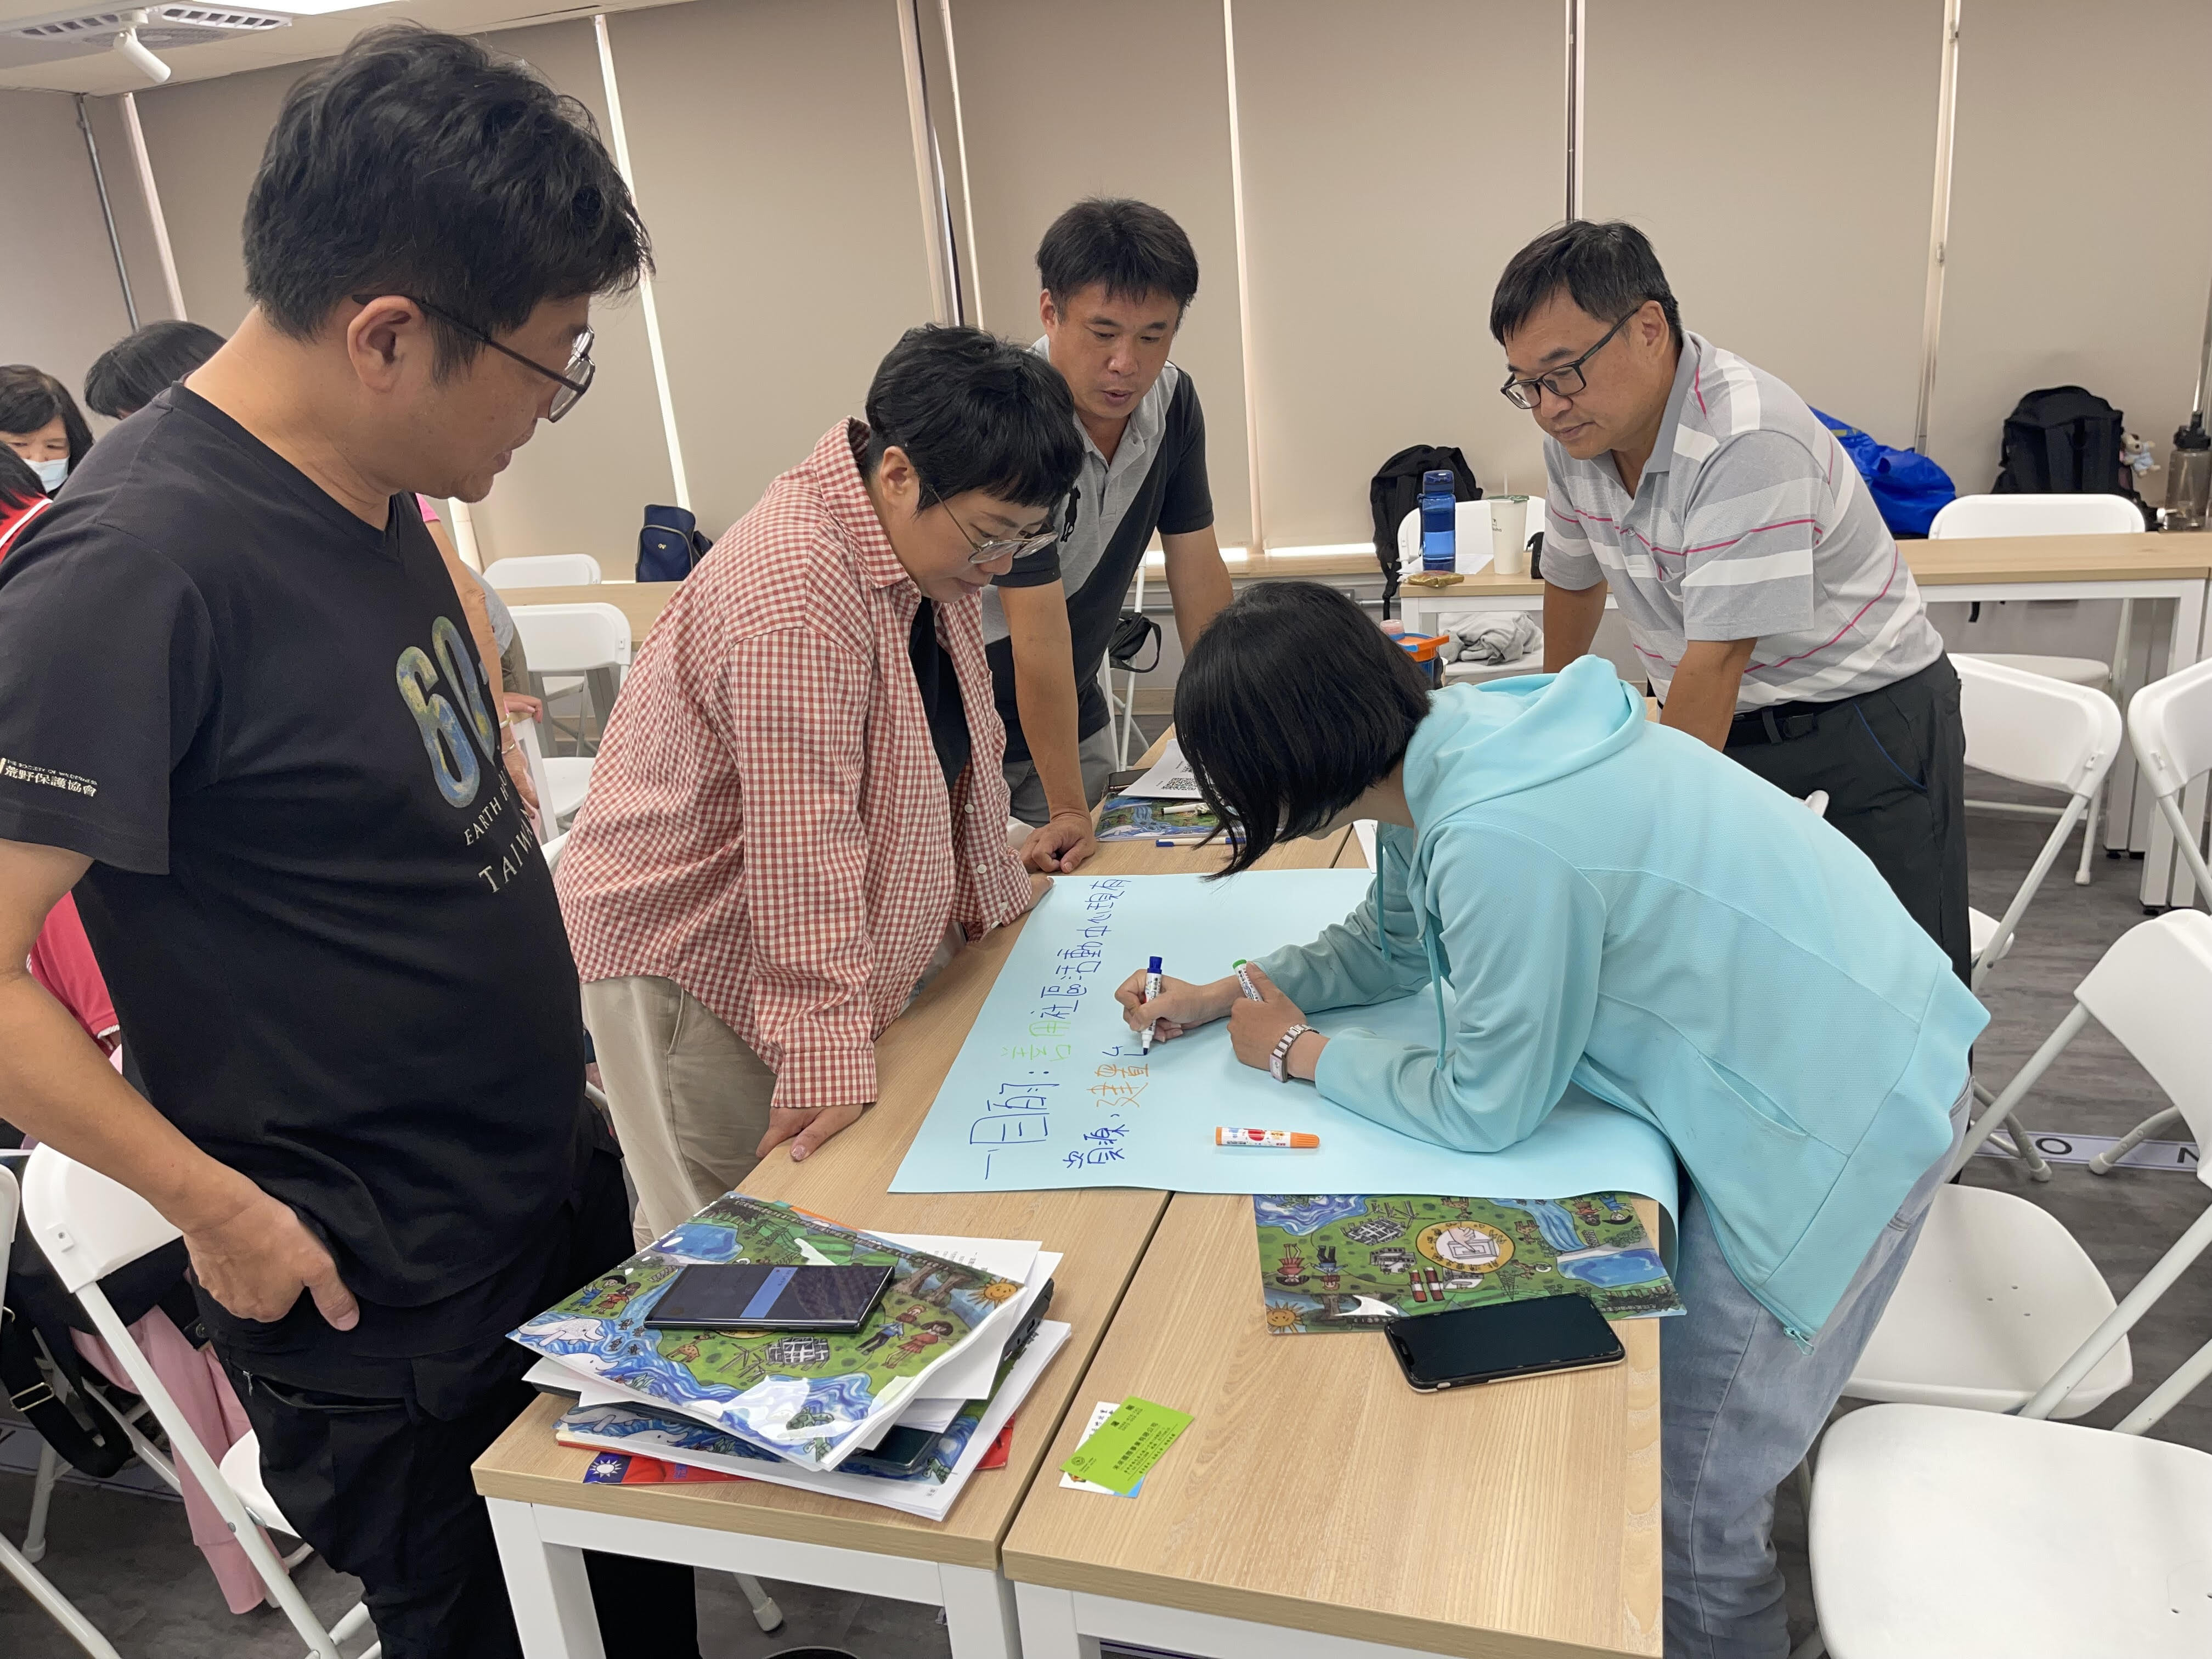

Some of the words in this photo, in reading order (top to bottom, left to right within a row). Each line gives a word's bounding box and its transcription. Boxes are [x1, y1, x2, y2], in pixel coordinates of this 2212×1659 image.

[396, 616, 494, 808] 60
[4, 765, 97, 797] 荒野保護協會
[465, 797, 501, 846] EARTH
